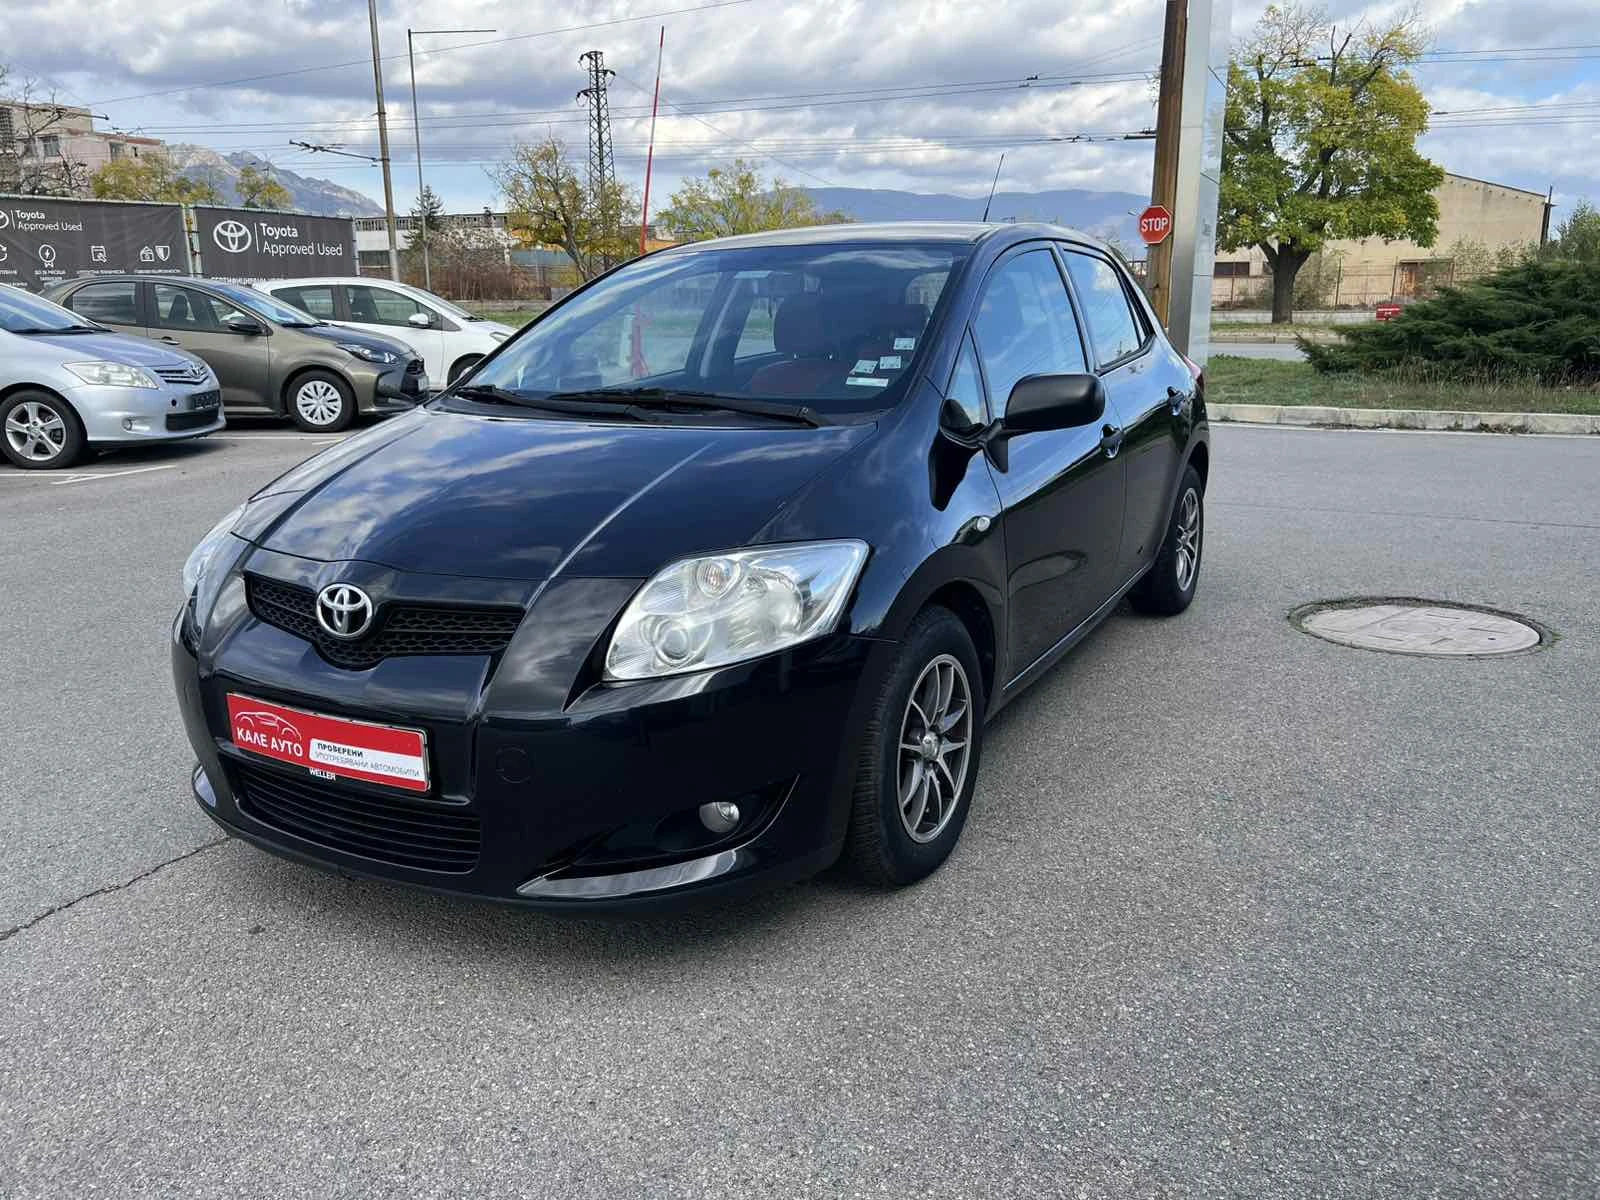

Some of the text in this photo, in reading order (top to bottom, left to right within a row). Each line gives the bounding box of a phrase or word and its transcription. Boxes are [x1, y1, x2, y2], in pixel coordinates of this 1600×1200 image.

[15, 209, 46, 221] Toyota
[18, 221, 82, 232] Approved Used
[260, 222, 299, 240] Toyota
[1141, 217, 1169, 232] STOP
[263, 240, 343, 257] Approved Used
[236, 727, 304, 758] КАЛЕ АУТО
[317, 742, 364, 758] ПРОВЕРЕНИ
[309, 768, 336, 781] WELLER
